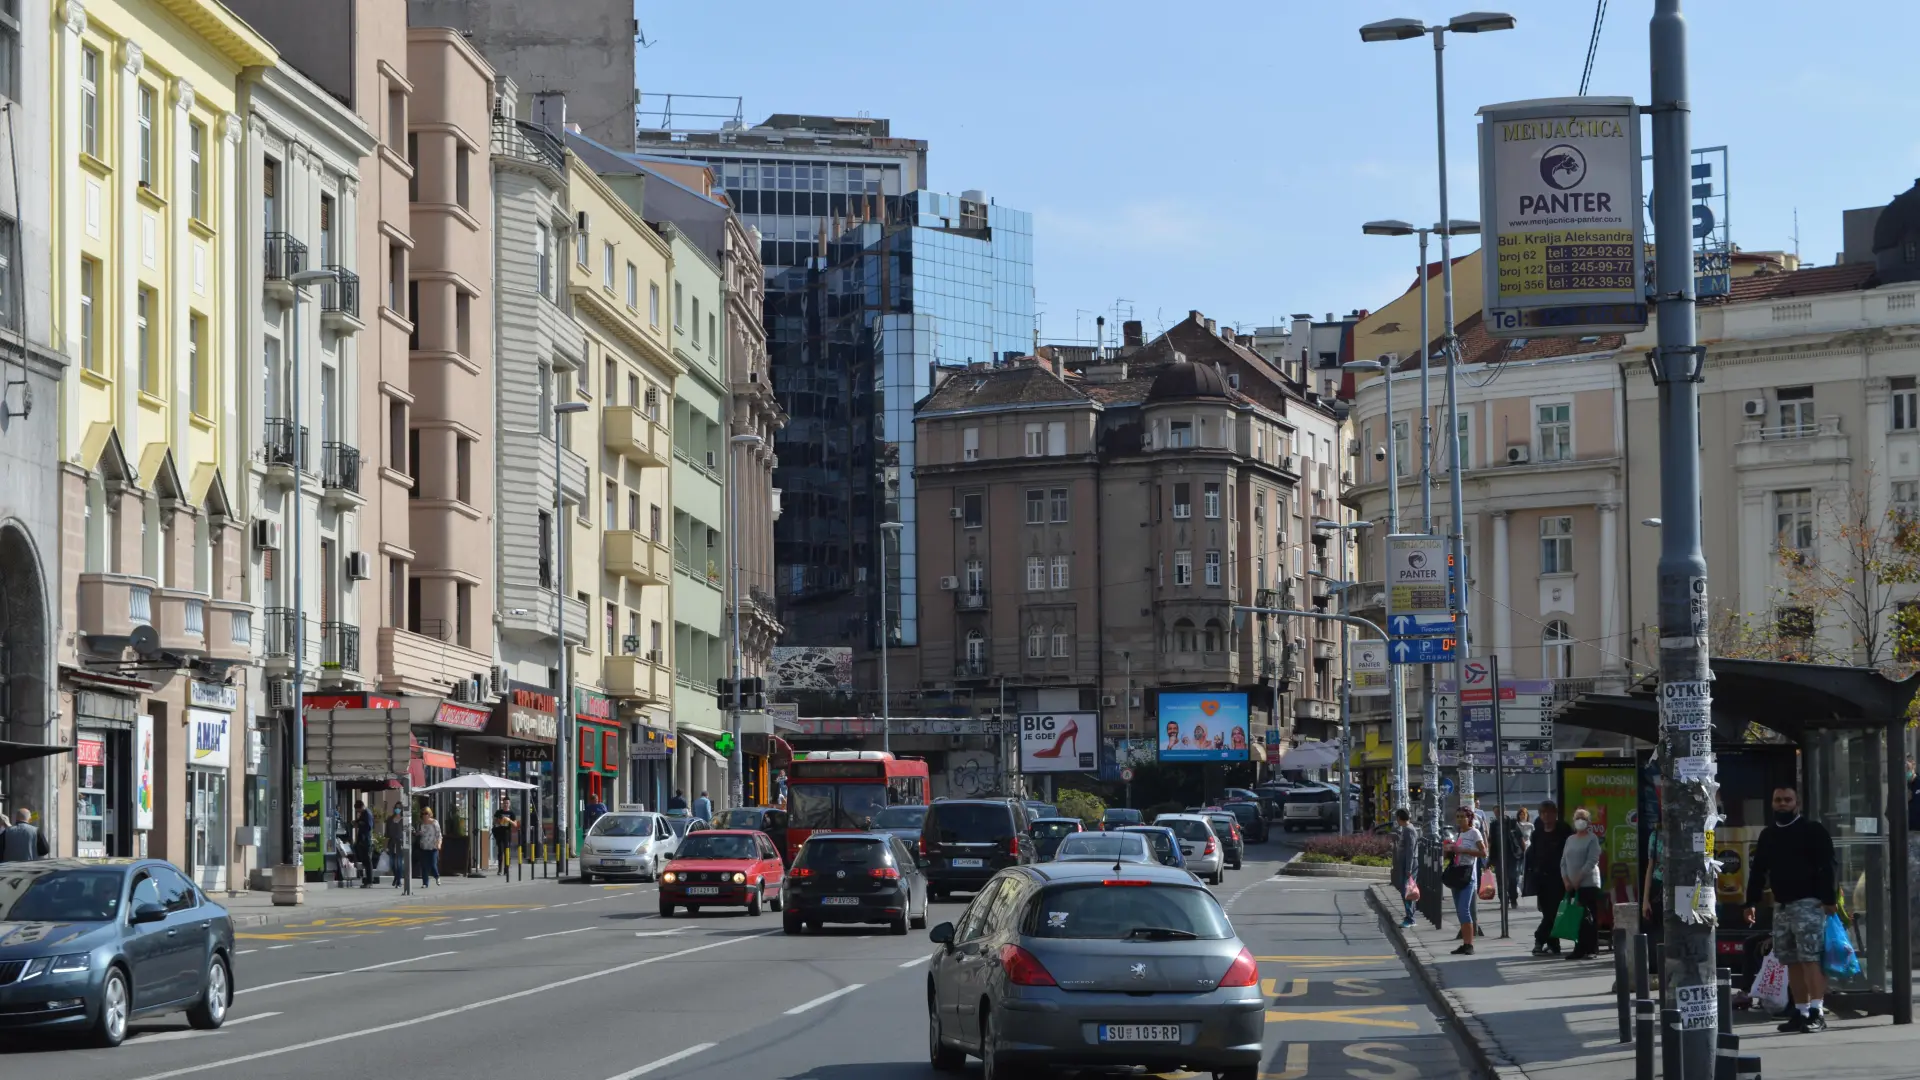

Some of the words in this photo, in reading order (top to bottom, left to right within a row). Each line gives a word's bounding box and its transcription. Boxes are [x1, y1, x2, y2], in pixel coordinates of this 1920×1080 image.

[1502, 117, 1625, 142] MENJAČNICA
[1520, 192, 1612, 215] PANTER
[1509, 215, 1622, 227] www.menjacnica-panter.co.rs
[1498, 236, 1521, 246] Bul.
[1525, 233, 1561, 245] Kralja
[1565, 231, 1633, 242] Aleksandra
[1500, 253, 1520, 262] broj
[1523, 250, 1536, 260] 62
[1548, 247, 1568, 258] tel:
[1571, 246, 1631, 257] 324-92-62
[1500, 268, 1520, 277] broj
[1524, 265, 1544, 275] 122
[1548, 263, 1568, 273] tel:
[1571, 261, 1632, 272] 245-99-77
[1500, 283, 1521, 292] broj
[1524, 280, 1544, 289] 356
[1549, 277, 1569, 288] tel:
[1572, 276, 1632, 287] 242-39-59
[1493, 310, 1529, 329] Tel:
[1400, 569, 1437, 578] PANTER
[1024, 716, 1055, 731] BIG
[1586, 775, 1634, 785] PONOSNI
[1260, 978, 1386, 997] US
[1109, 1026, 1125, 1040] SU
[1135, 1026, 1178, 1040] 105-RP
